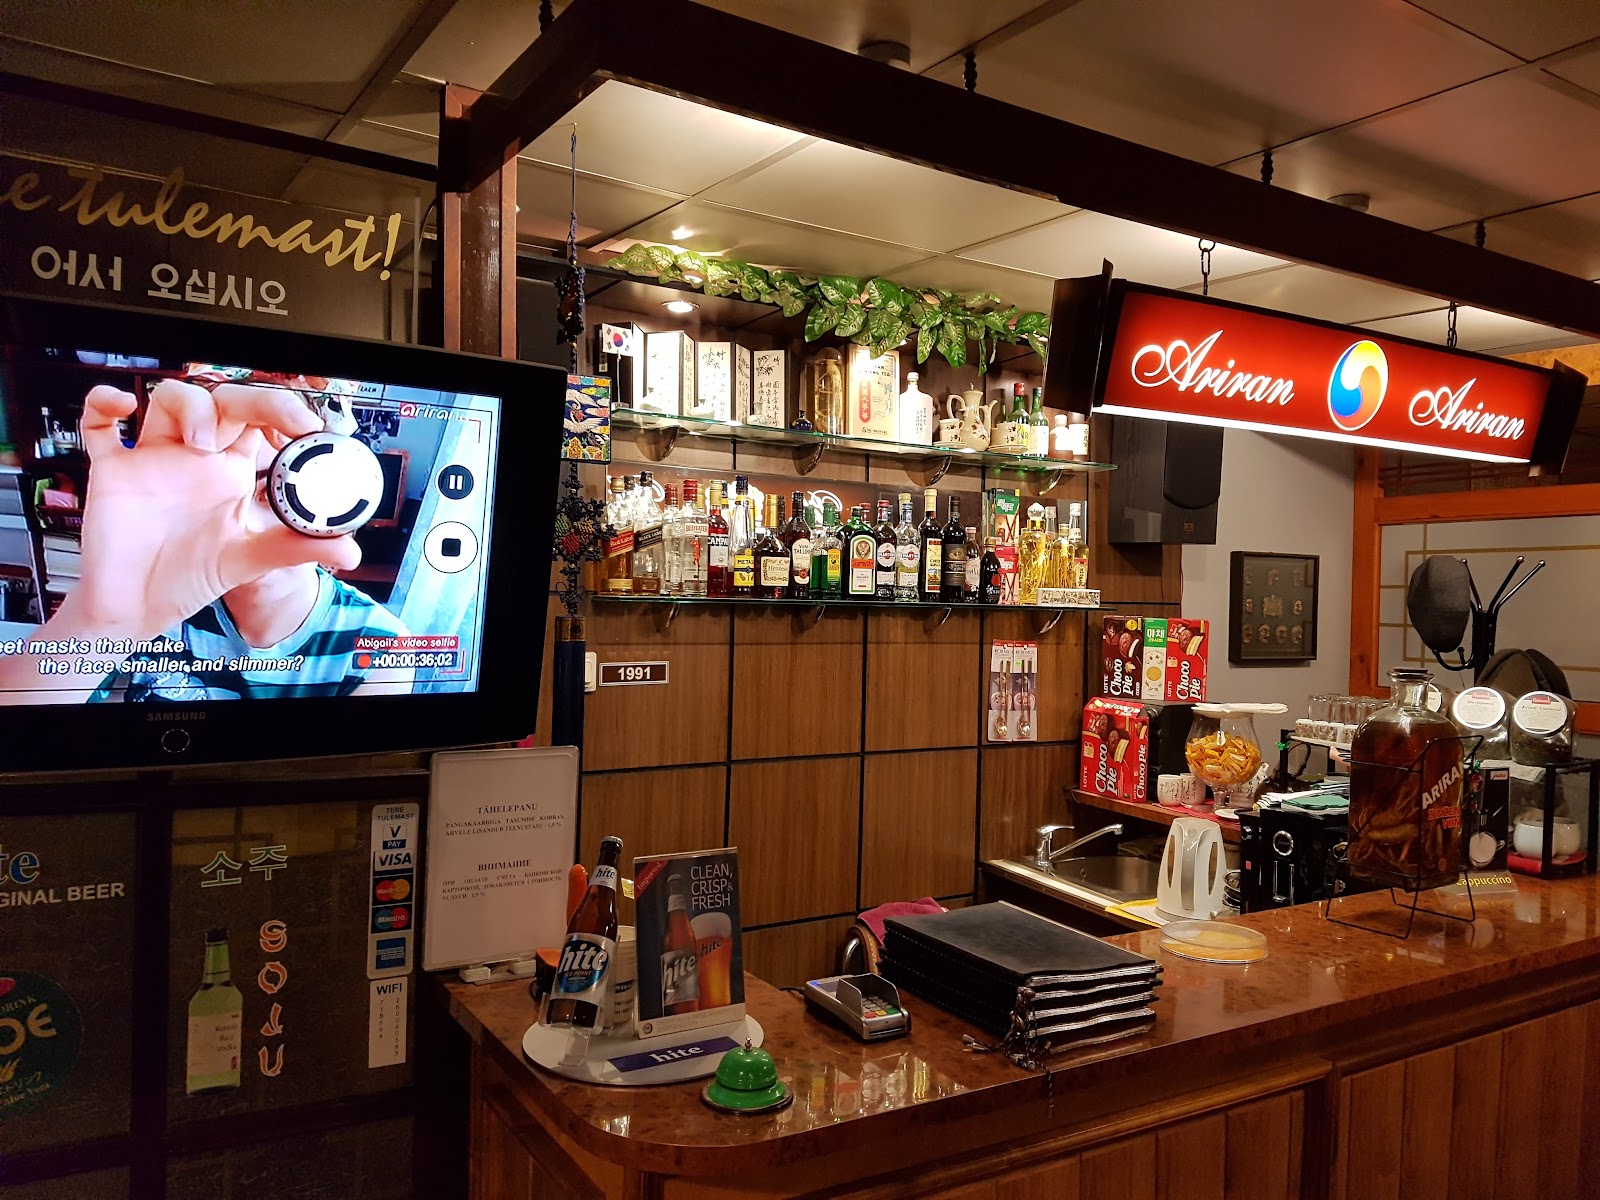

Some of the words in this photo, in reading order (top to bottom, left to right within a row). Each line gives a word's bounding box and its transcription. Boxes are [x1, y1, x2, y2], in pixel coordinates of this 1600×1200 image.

[58, 167, 402, 281] tulemast!
[31, 246, 122, 291] 어서
[148, 263, 288, 316] 오십시오
[1131, 329, 1295, 406] Ariran
[1408, 377, 1526, 441] Ariran
[1147, 628, 1165, 639] 야채
[30, 639, 91, 654] masks
[96, 637, 132, 653] that
[137, 638, 185, 653] make
[357, 638, 399, 650] Abigail's
[401, 638, 428, 648] video
[430, 637, 456, 647] selfie
[38, 658, 70, 674] the
[74, 658, 115, 674] face
[121, 657, 185, 673] smaller
[191, 656, 224, 672] and
[228, 655, 305, 672] slimmer?
[618, 667, 651, 681] 1991
[1110, 658, 1123, 696] Choco
[1176, 660, 1190, 700] Choco
[147, 712, 206, 721] SAMSUNG
[1095, 743, 1108, 793] Choco
[377, 813, 415, 822] TULEMAST
[386, 806, 404, 814] TERE
[477, 803, 538, 815] TÄHELEPANU
[506, 816, 535, 824] TASUMISE
[445, 828, 471, 836] ARVELE
[200, 845, 289, 889] 소주
[378, 852, 412, 867] VISA
[478, 859, 532, 871] ВНИМАНИЕ
[596, 867, 615, 879] hite
[637, 861, 662, 890] Imported
[690, 863, 733, 880] CLEAN,
[66, 882, 125, 902] BEER
[691, 893, 731, 911] FRESH
[701, 937, 723, 958] hite
[558, 943, 608, 974] hite
[663, 955, 697, 987] hite
[376, 983, 402, 995] WIFI
[649, 1046, 704, 1063] hite
